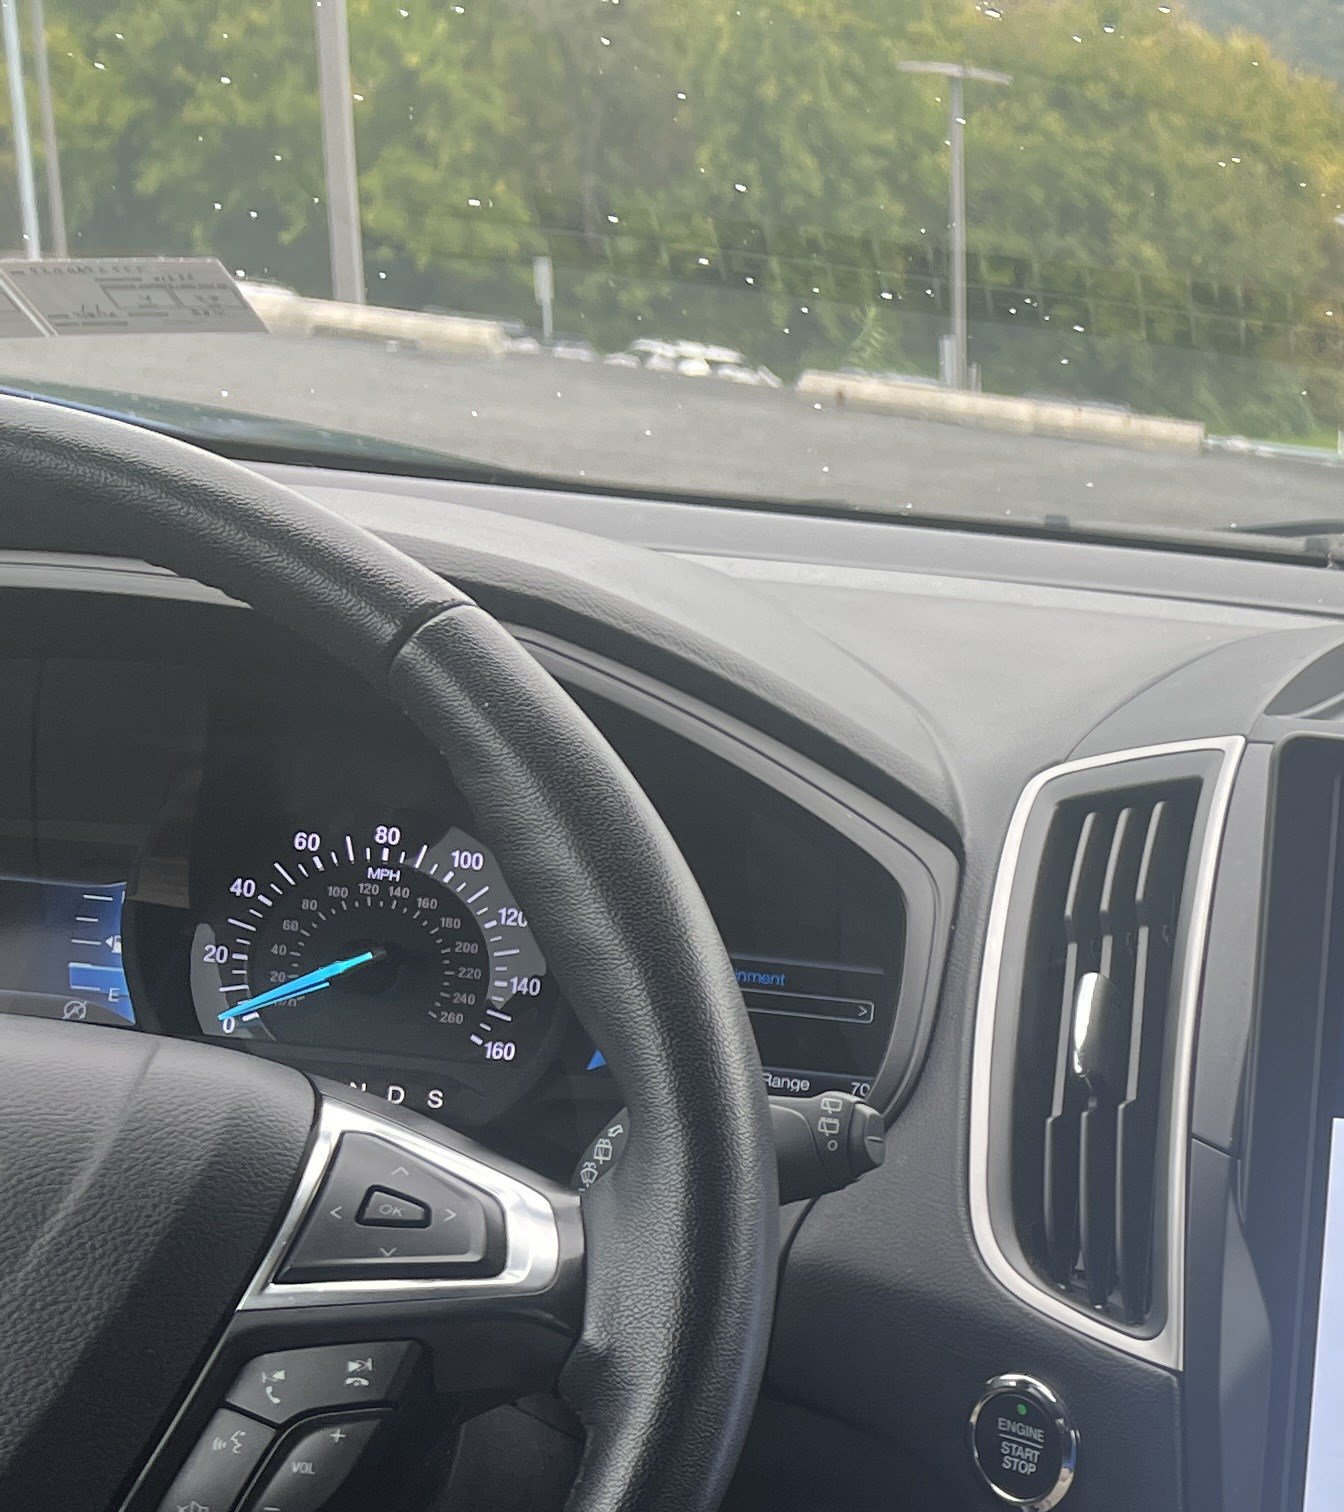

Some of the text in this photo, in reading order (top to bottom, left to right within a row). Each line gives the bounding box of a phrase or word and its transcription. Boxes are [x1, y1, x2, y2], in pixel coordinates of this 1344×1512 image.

[293, 831, 321, 851] 60
[374, 825, 401, 845] 80
[450, 849, 484, 871] 100
[366, 866, 401, 882] MPH
[229, 877, 256, 898] 40
[203, 944, 229, 964] 20
[454, 941, 479, 955] 200
[457, 966, 482, 980] 220
[107, 987, 121, 1003] E
[509, 975, 541, 997] 140
[222, 1016, 235, 1034] 0
[483, 1041, 516, 1061] 160
[763, 1072, 811, 1093] Range
[387, 1085, 406, 1104] D
[427, 1088, 444, 1109] S
[379, 1203, 403, 1217] OK
[998, 1417, 1045, 1443] ENGINE
[1000, 1441, 1041, 1463] START
[291, 1461, 316, 1475] VOL
[1002, 1455, 1037, 1475] STOP
